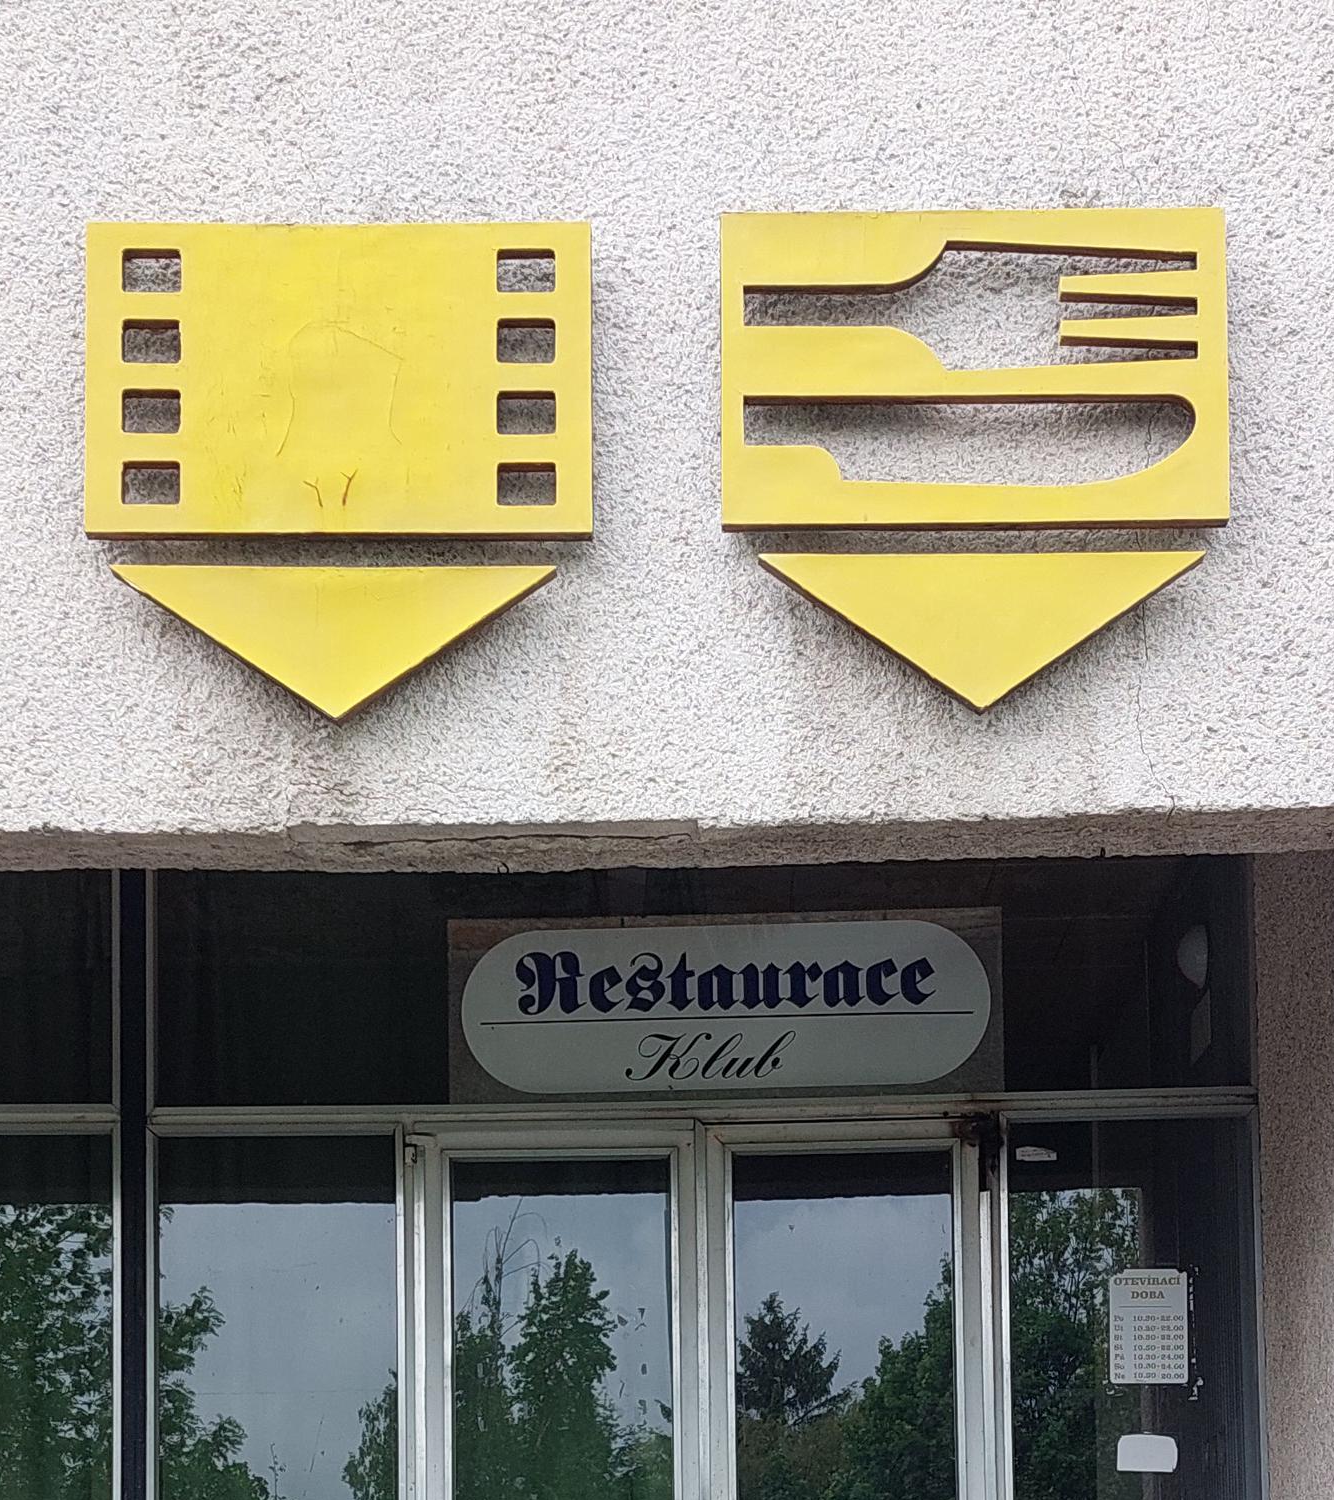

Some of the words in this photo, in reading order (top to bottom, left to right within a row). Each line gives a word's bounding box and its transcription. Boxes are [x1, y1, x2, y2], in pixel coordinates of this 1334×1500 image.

[515, 949, 936, 1017] Restaurace
[625, 1030, 796, 1082] Klub
[1113, 1274, 1181, 1286] OTEVÍRACÍ
[1131, 1290, 1165, 1300] DOBA
